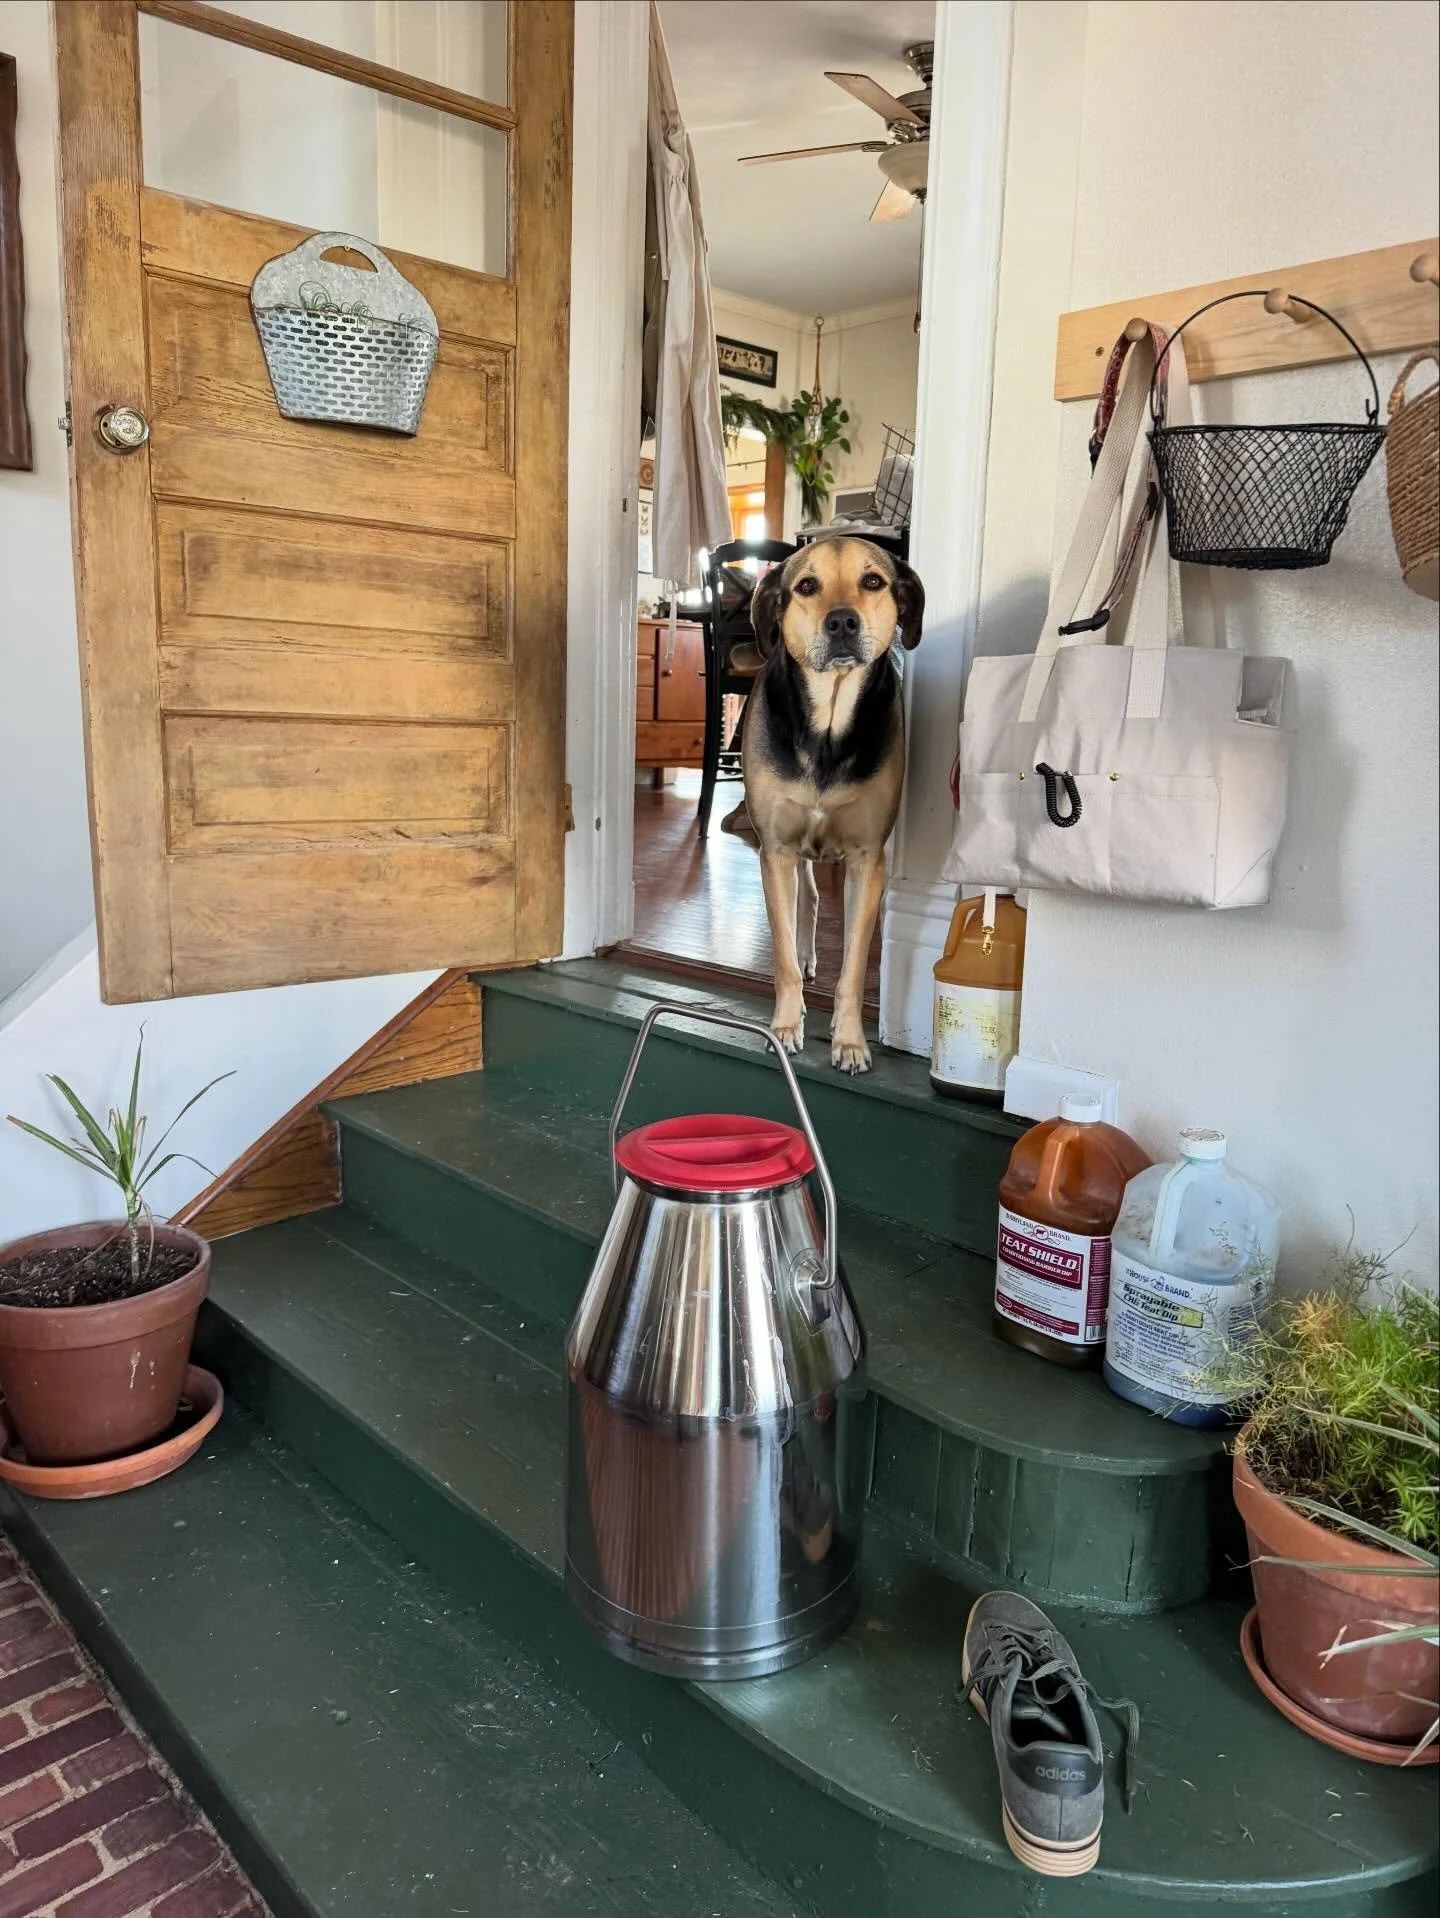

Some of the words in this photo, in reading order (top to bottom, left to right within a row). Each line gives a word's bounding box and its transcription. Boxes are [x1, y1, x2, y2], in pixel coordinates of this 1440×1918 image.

[1049, 1230, 1071, 1241] BRAND
[1001, 1232, 1028, 1253] TEAT
[1028, 1246, 1078, 1270] SHIELD
[1123, 1282, 1180, 1312] Sprayable
[1165, 1284, 1190, 1298] BRAND
[1140, 1300, 1161, 1316] Teat
[1162, 1310, 1179, 1322] Dip
[1035, 1766, 1086, 1781] adidas
